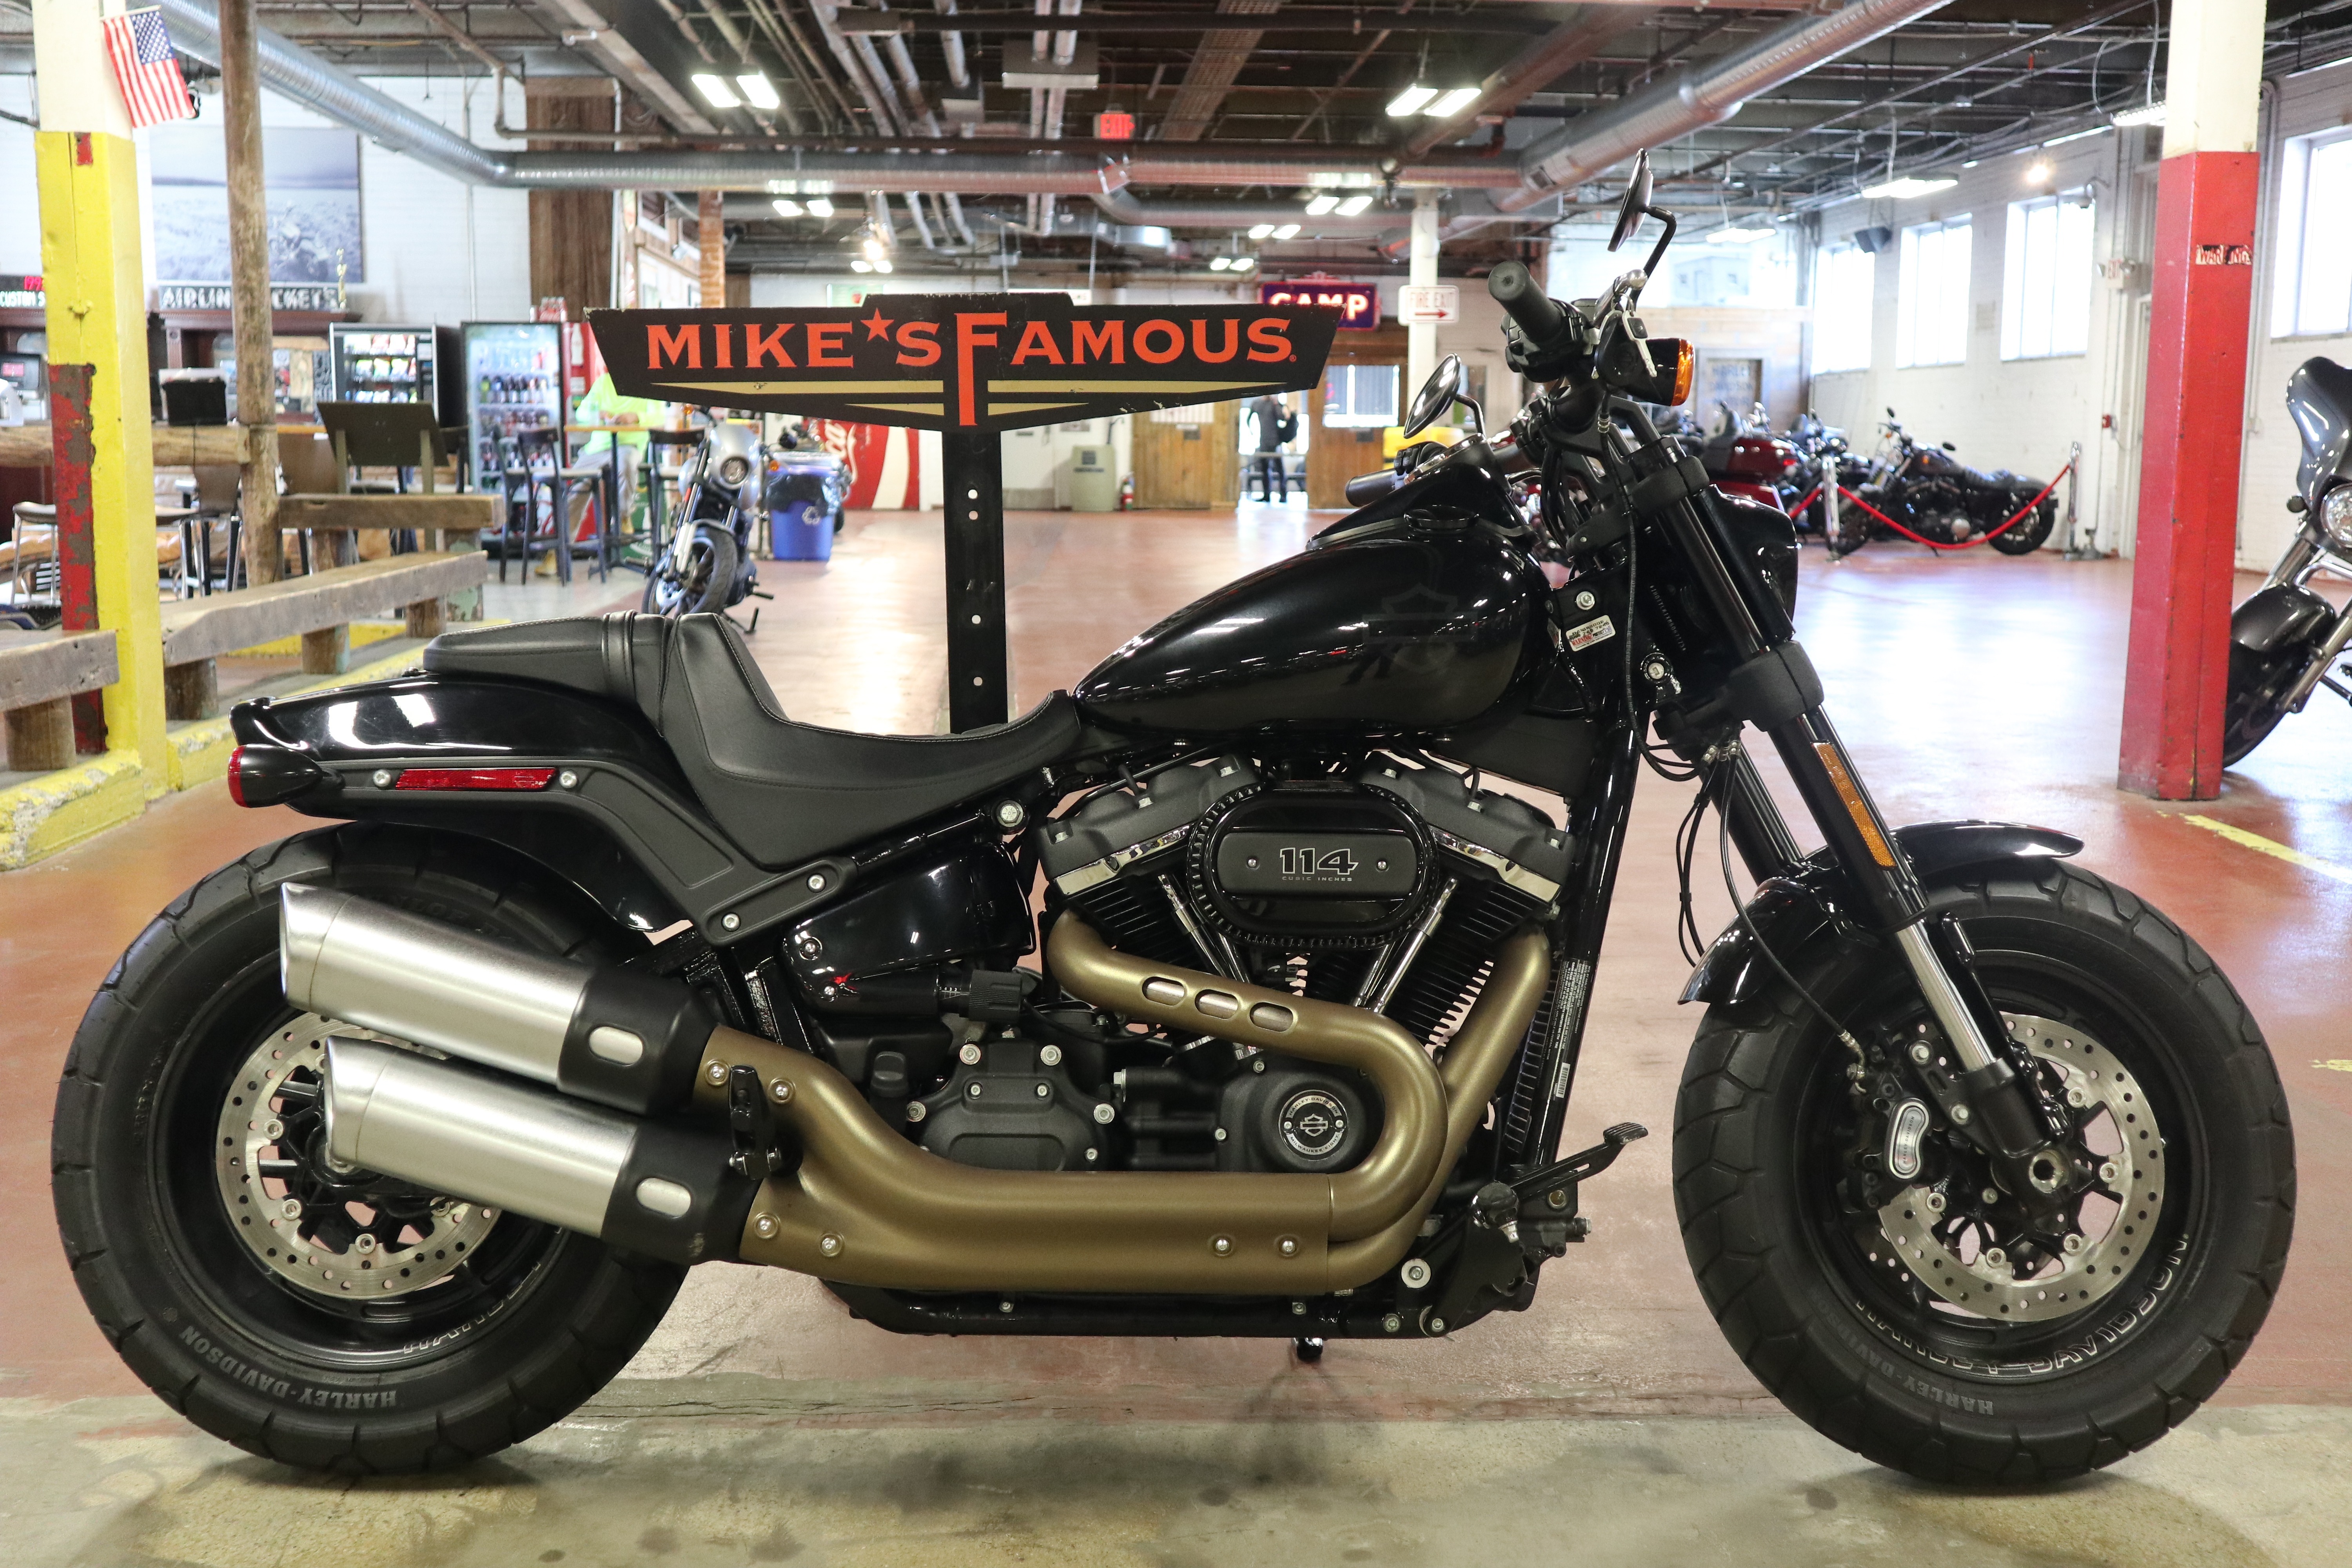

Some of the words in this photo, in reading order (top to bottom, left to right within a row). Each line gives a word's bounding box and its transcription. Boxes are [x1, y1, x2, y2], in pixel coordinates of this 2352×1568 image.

[162, 287, 231, 309] AIRLIN
[1410, 292, 1430, 308] FIRE
[1434, 292, 1454, 308] EXIT
[646, 308, 941, 369] MIKE'S
[955, 310, 1292, 426] FAMOUS
[1279, 847, 1359, 875] 114
[1289, 1098, 1338, 1115] HARLEY-DAVIDSON
[1290, 1134, 1339, 1153] MILWAUKEE-EIGHT
[1903, 1116, 1915, 1164] HARLEY-DAVIDSON
